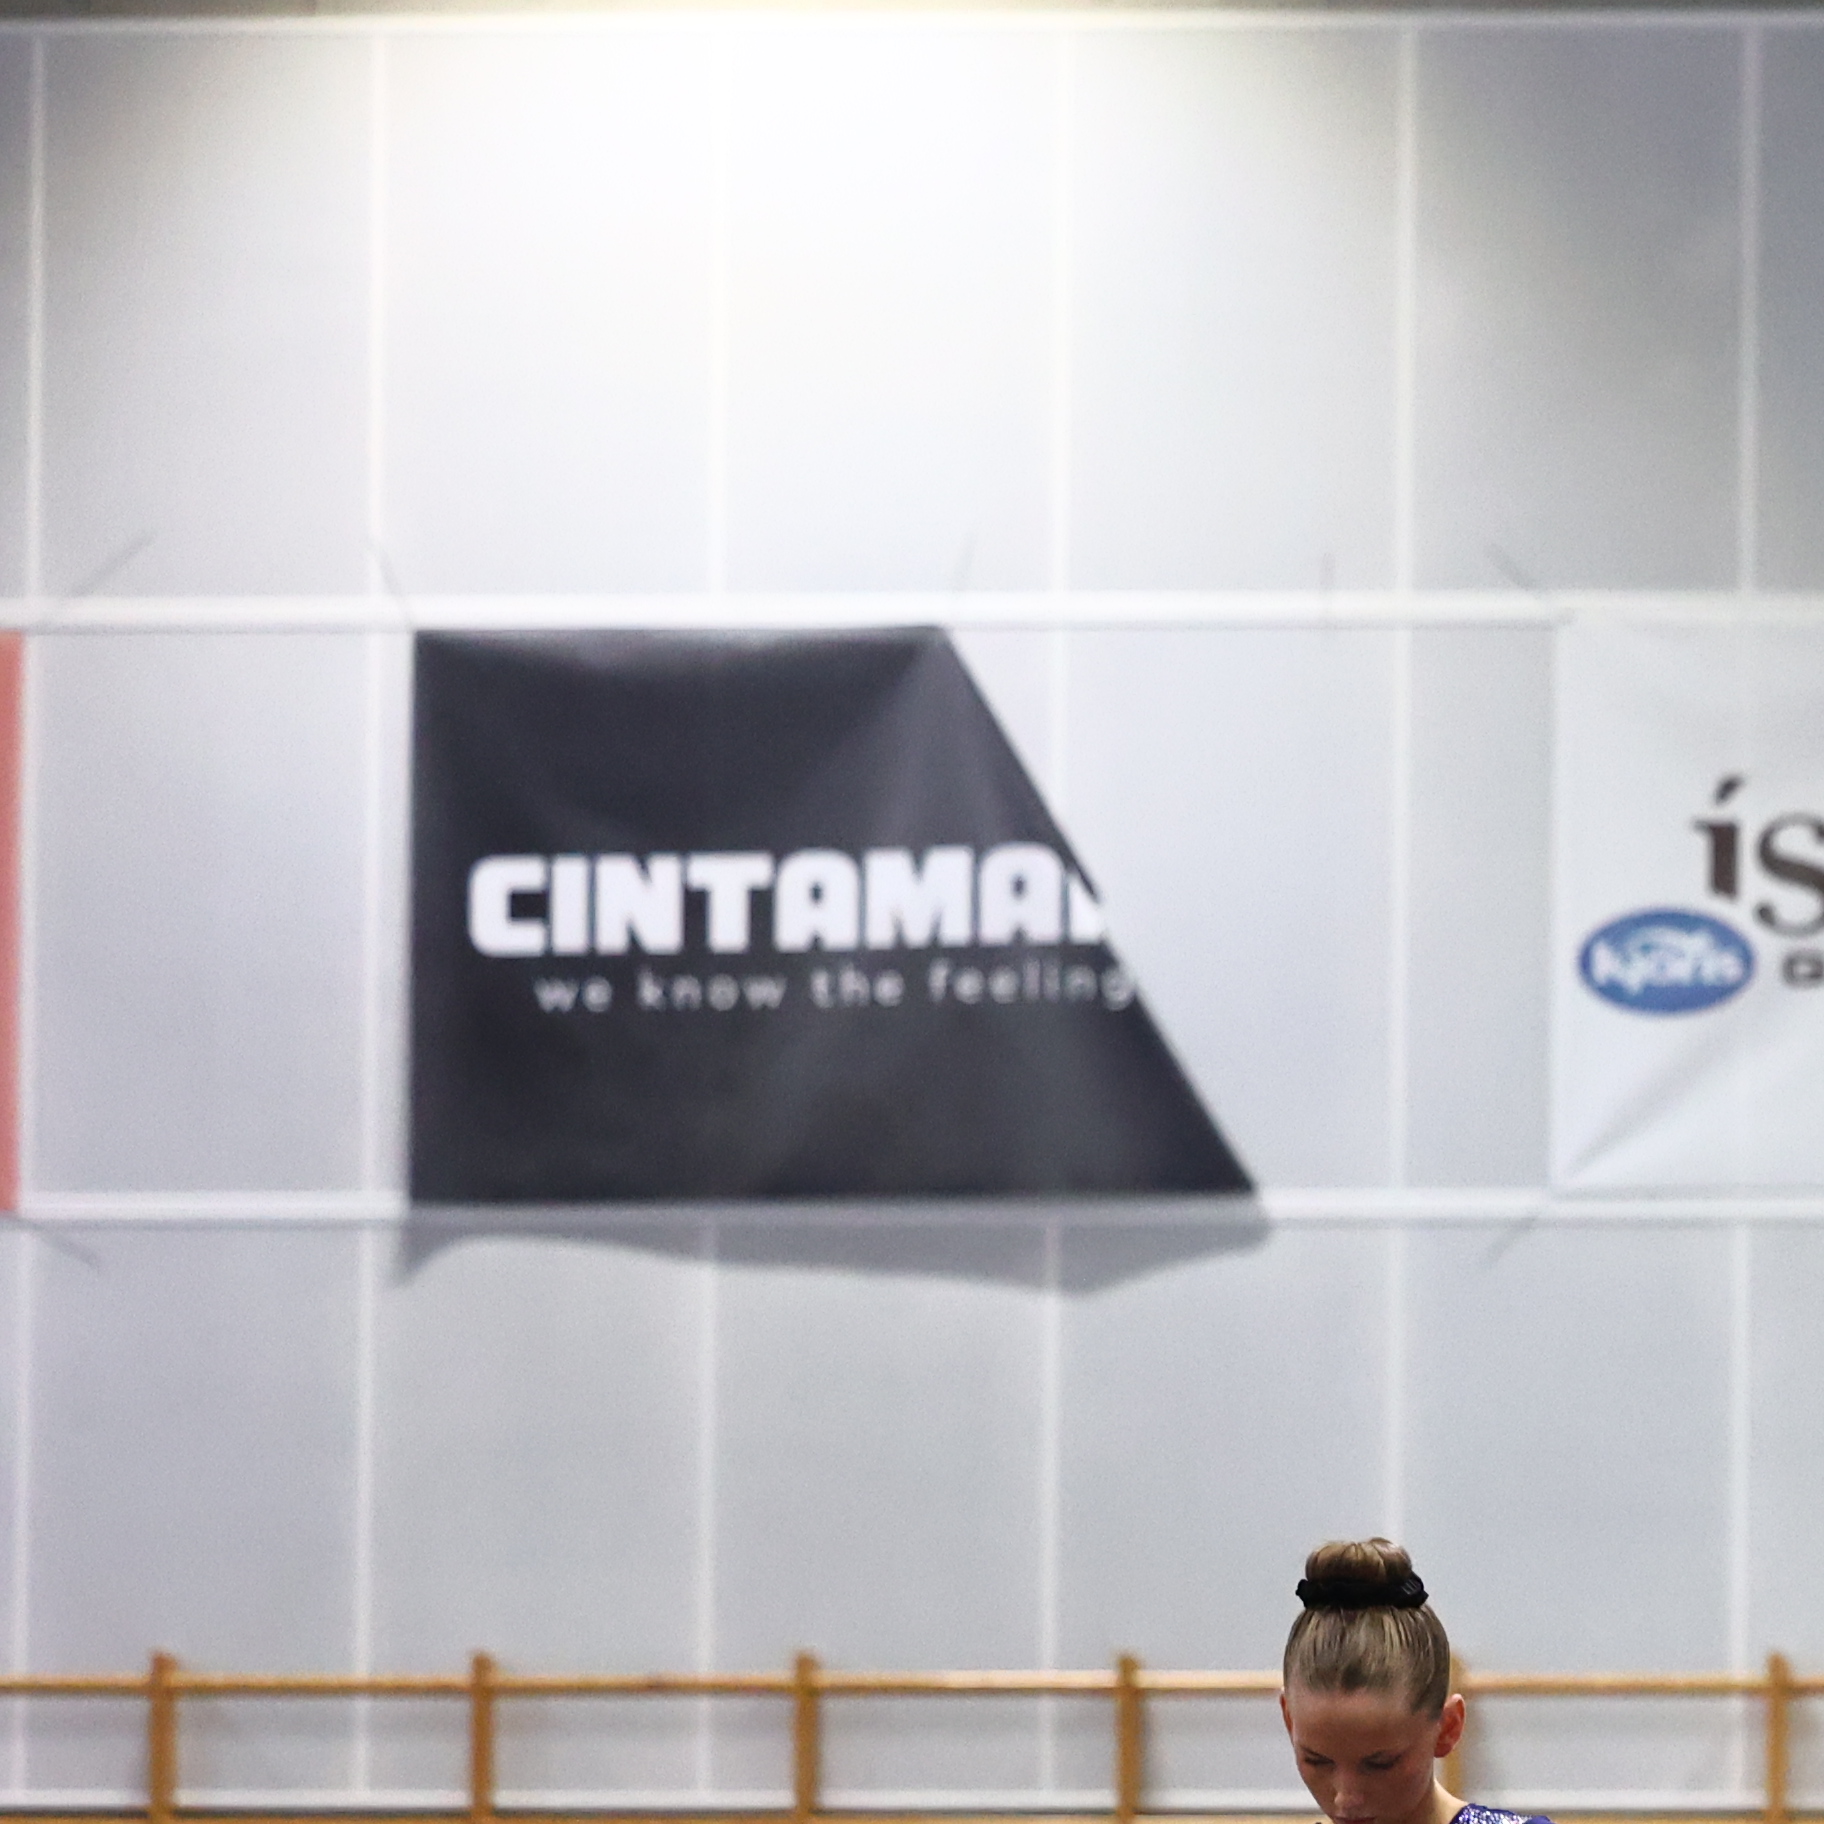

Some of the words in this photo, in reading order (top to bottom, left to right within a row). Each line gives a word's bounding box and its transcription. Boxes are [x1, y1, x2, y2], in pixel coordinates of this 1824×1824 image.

[533, 975, 613, 1014] we
[636, 968, 788, 1013] know
[810, 963, 906, 1010] the
